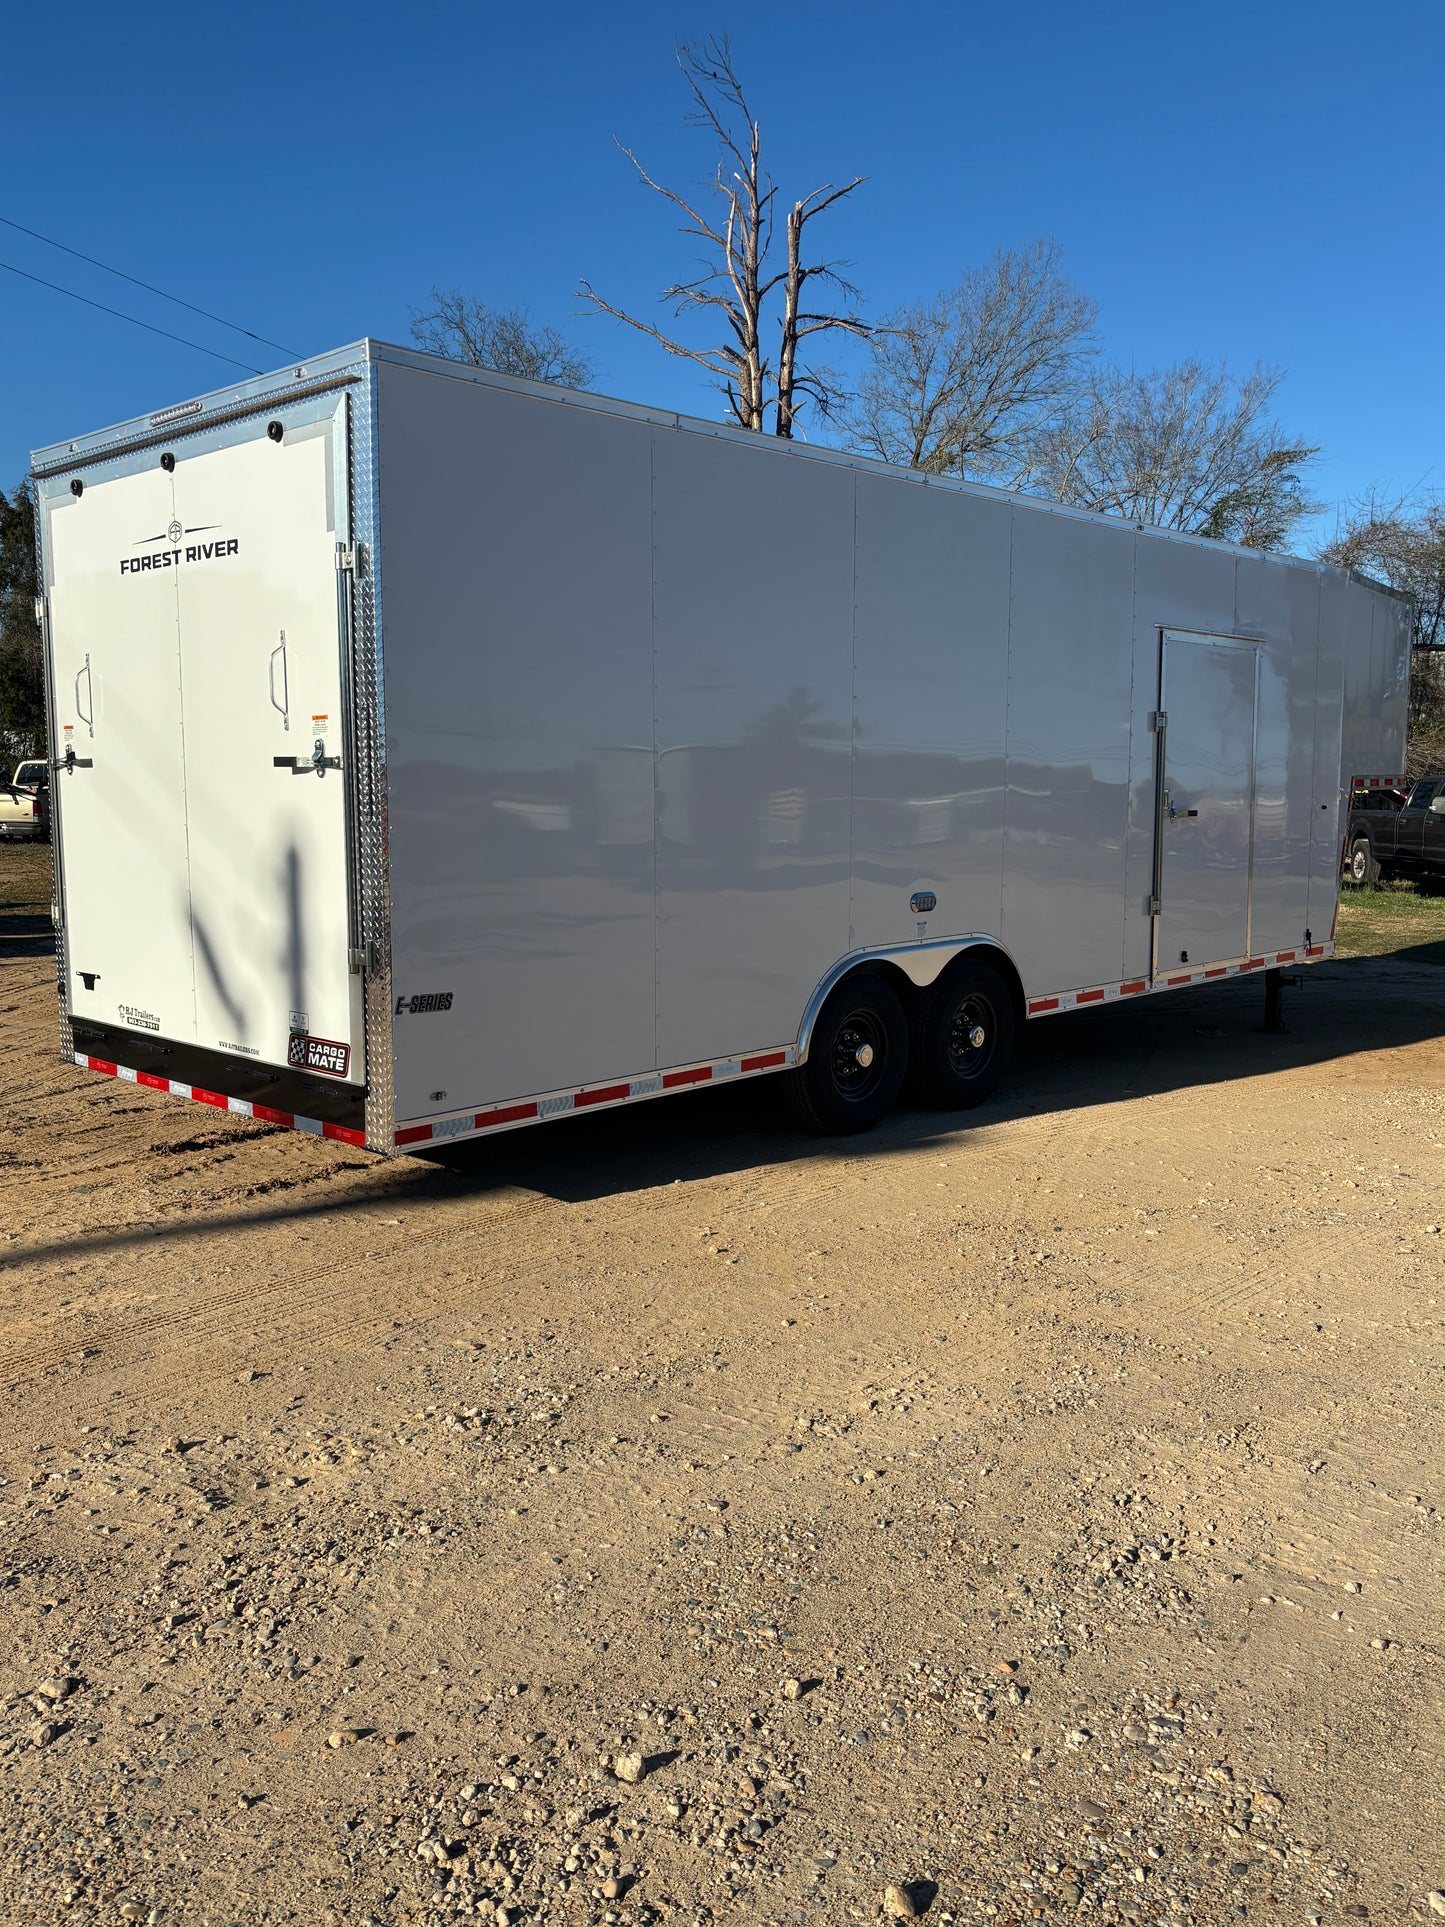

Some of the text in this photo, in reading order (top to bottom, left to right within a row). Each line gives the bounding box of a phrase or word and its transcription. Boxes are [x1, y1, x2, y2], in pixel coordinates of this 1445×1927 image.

[119, 538, 239, 575] FOREST RIVER
[395, 992, 453, 1016] E-SERIES
[309, 1042, 346, 1058] CARGO
[308, 1052, 345, 1071] MATE
